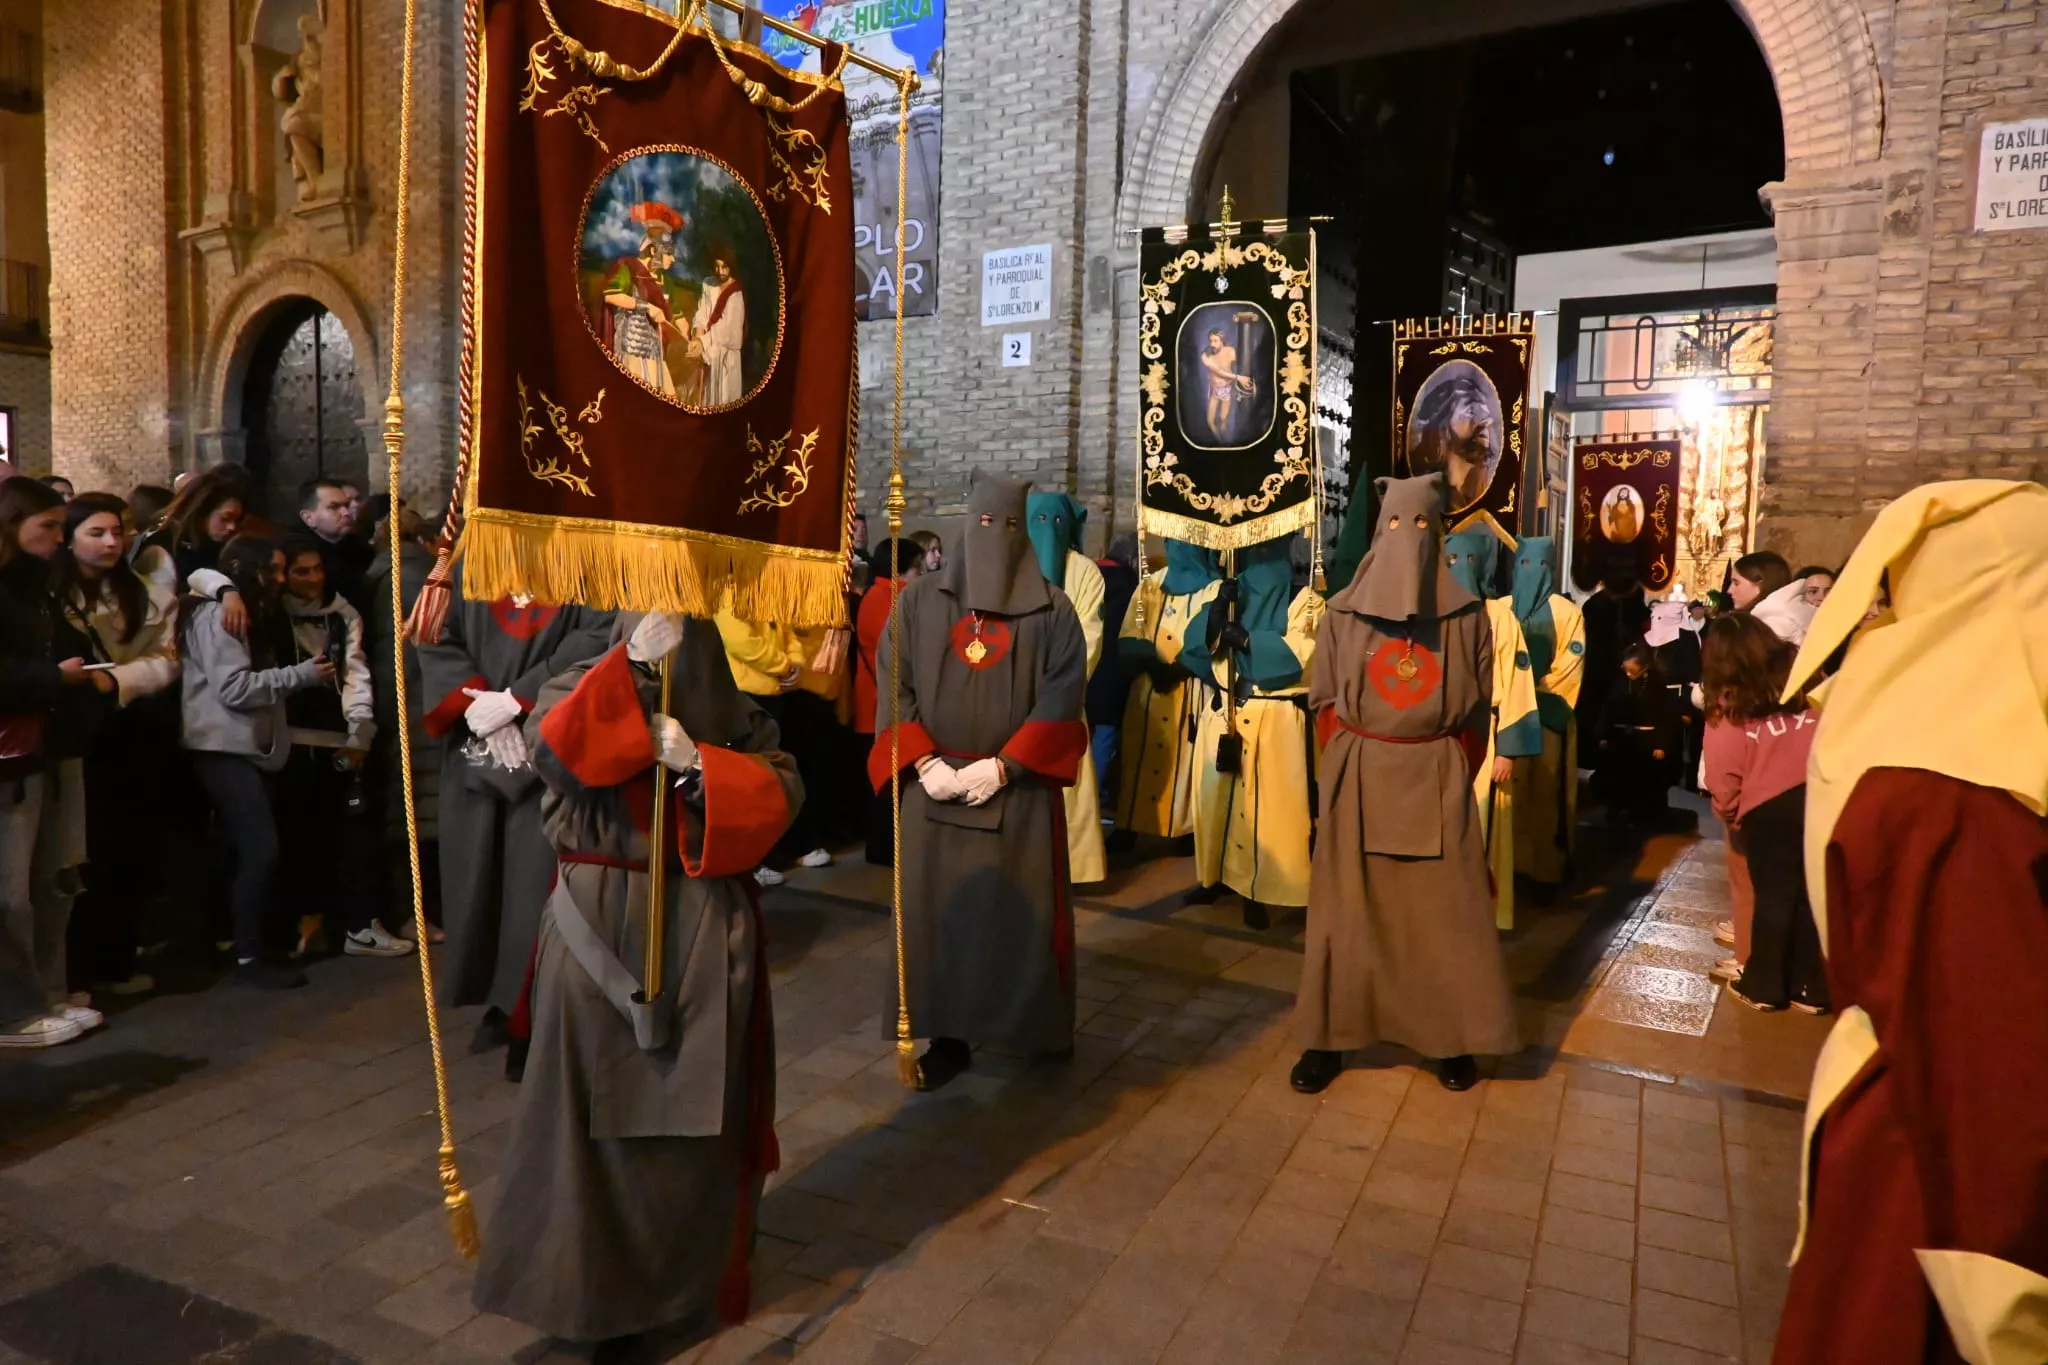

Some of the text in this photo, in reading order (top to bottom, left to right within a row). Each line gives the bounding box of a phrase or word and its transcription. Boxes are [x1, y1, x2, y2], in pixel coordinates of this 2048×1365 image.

[854, 0, 934, 34] HUESCA
[1993, 127, 2048, 150] BASILI
[1994, 156, 2004, 173] Y
[989, 269, 1044, 286] Y PARROQUIAL
[1011, 340, 1022, 359] 2
